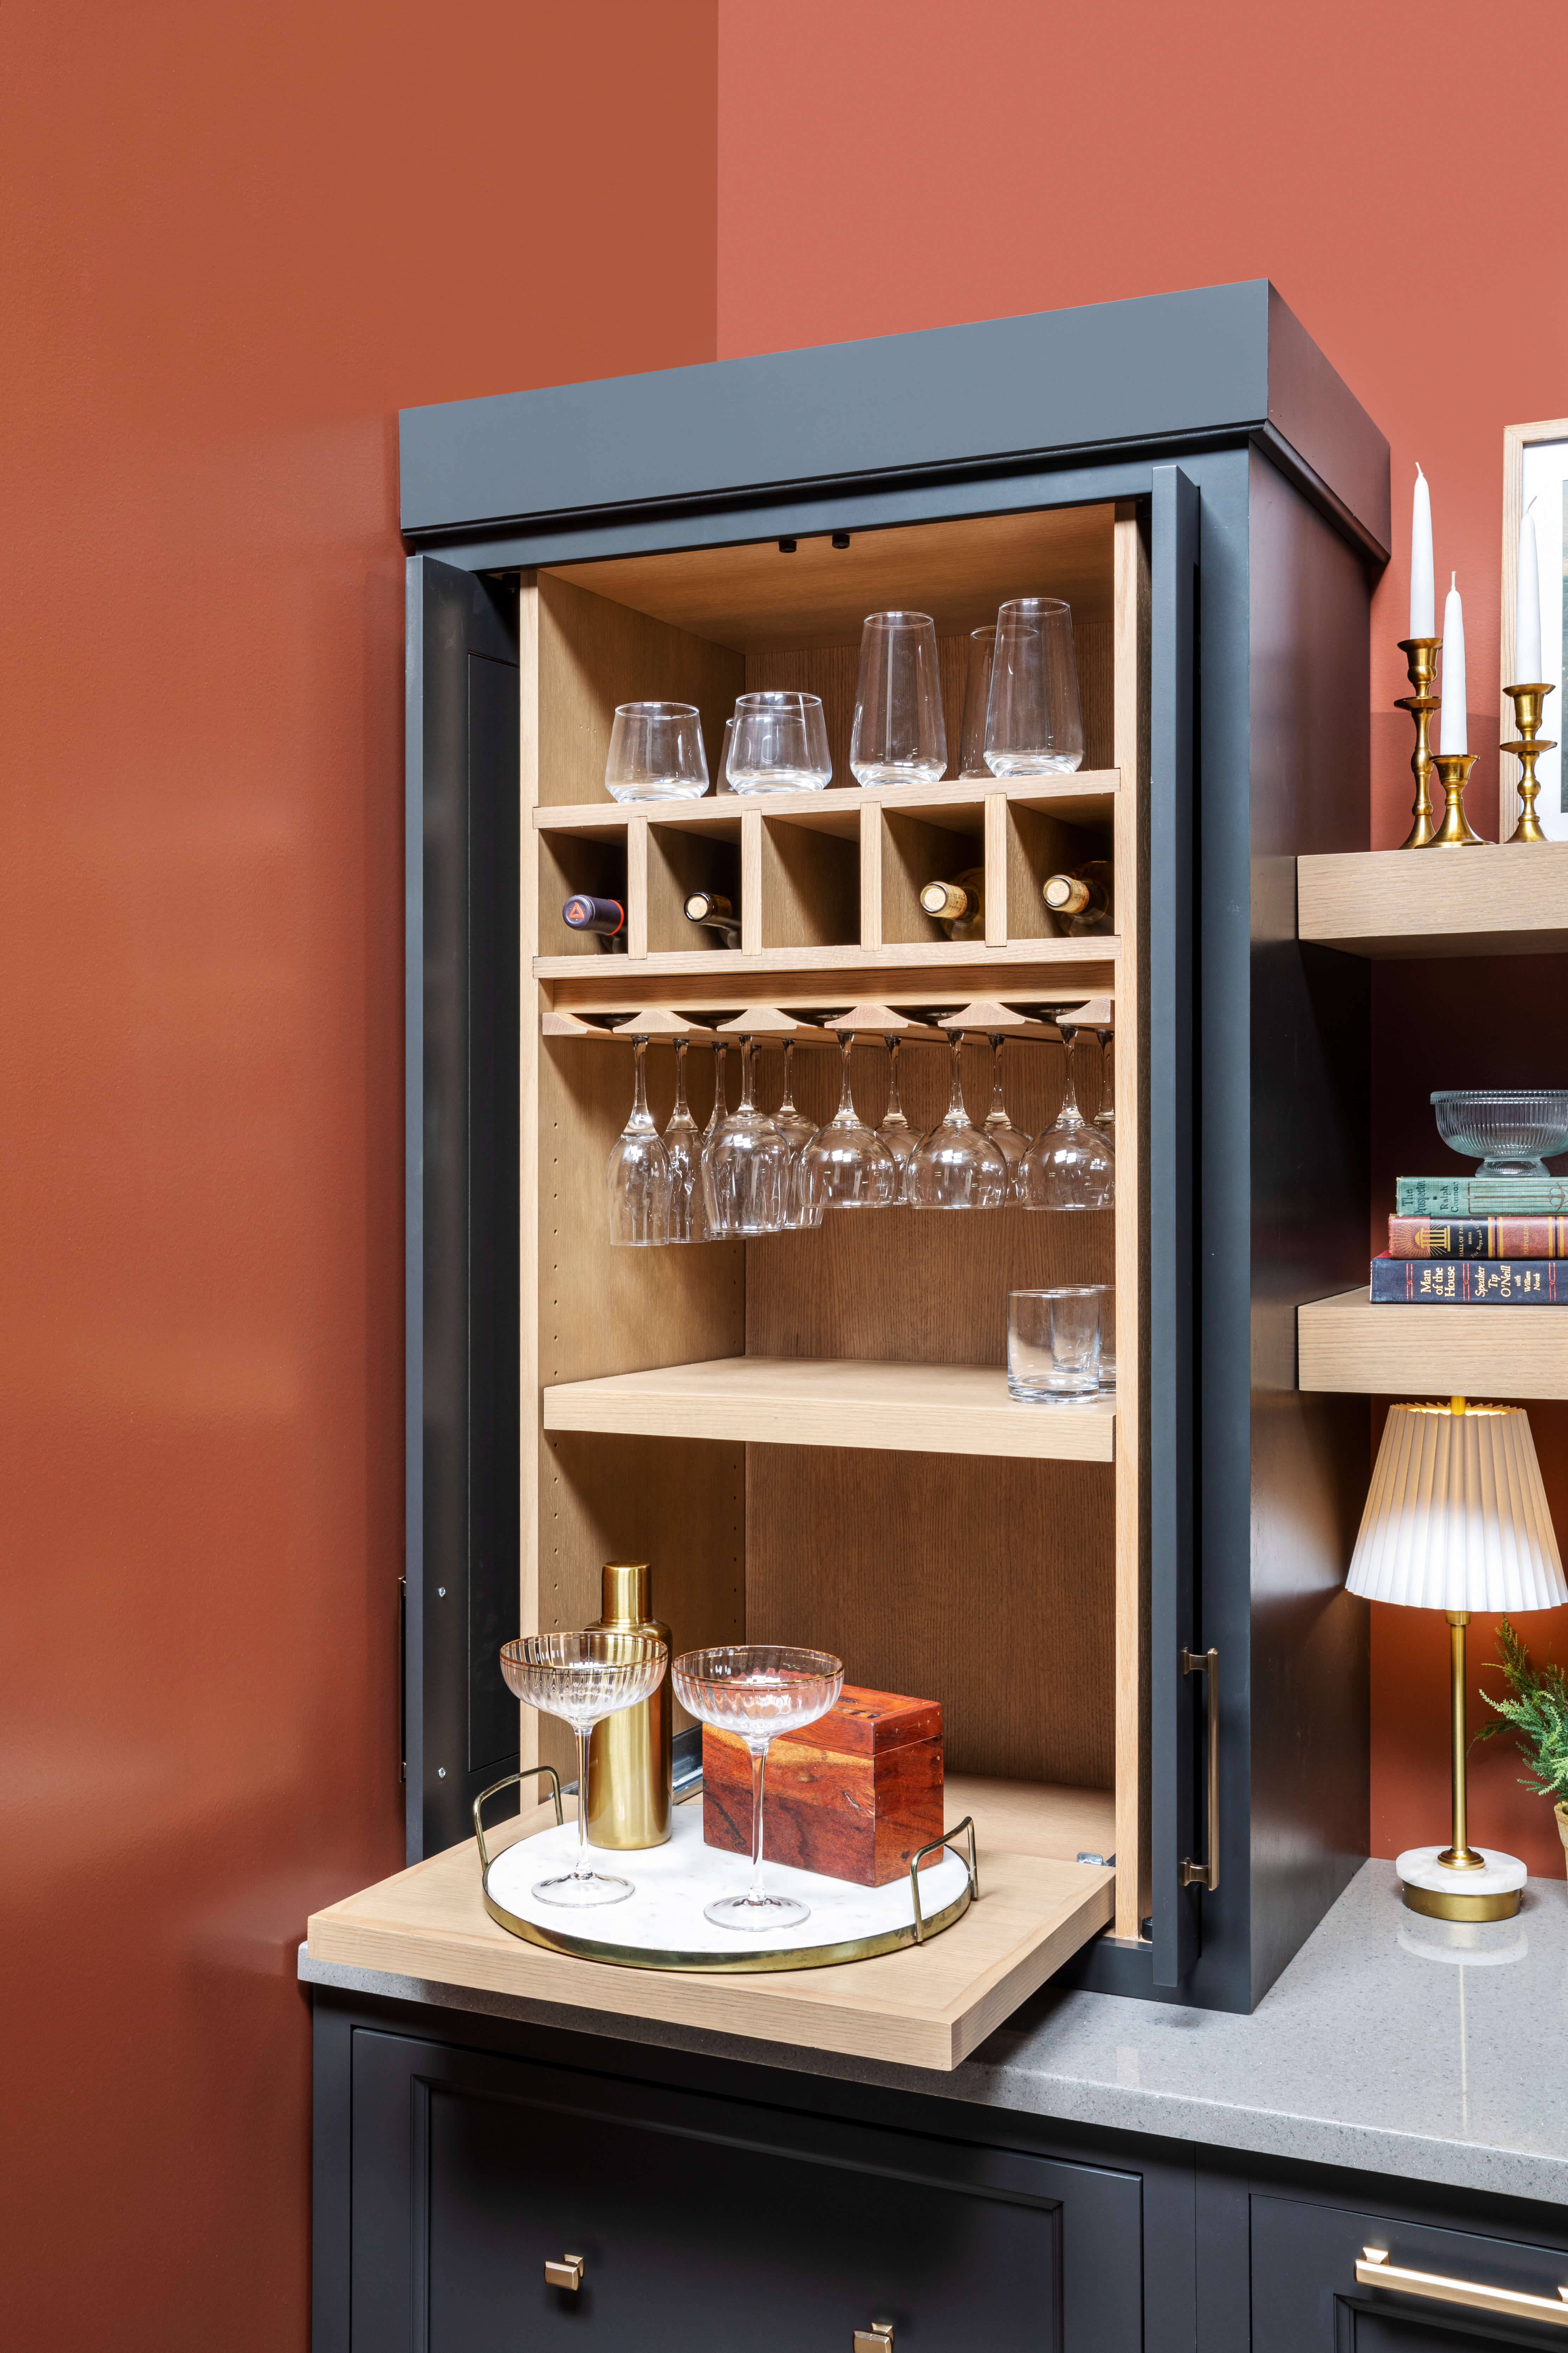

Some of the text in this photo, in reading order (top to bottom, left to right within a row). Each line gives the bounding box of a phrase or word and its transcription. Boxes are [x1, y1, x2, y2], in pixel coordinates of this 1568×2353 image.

[1402, 1189, 1413, 1206] The
[1440, 1185, 1451, 1210] Ralph
[1451, 1182, 1459, 1212] Connor
[1421, 1269, 1431, 1293] Man
[1432, 1267, 1443, 1295] of the
[1445, 1266, 1455, 1297] House
[1475, 1266, 1488, 1297] Speaker
[1488, 1274, 1501, 1288] Tip
[1501, 1265, 1511, 1297] O'Neill
